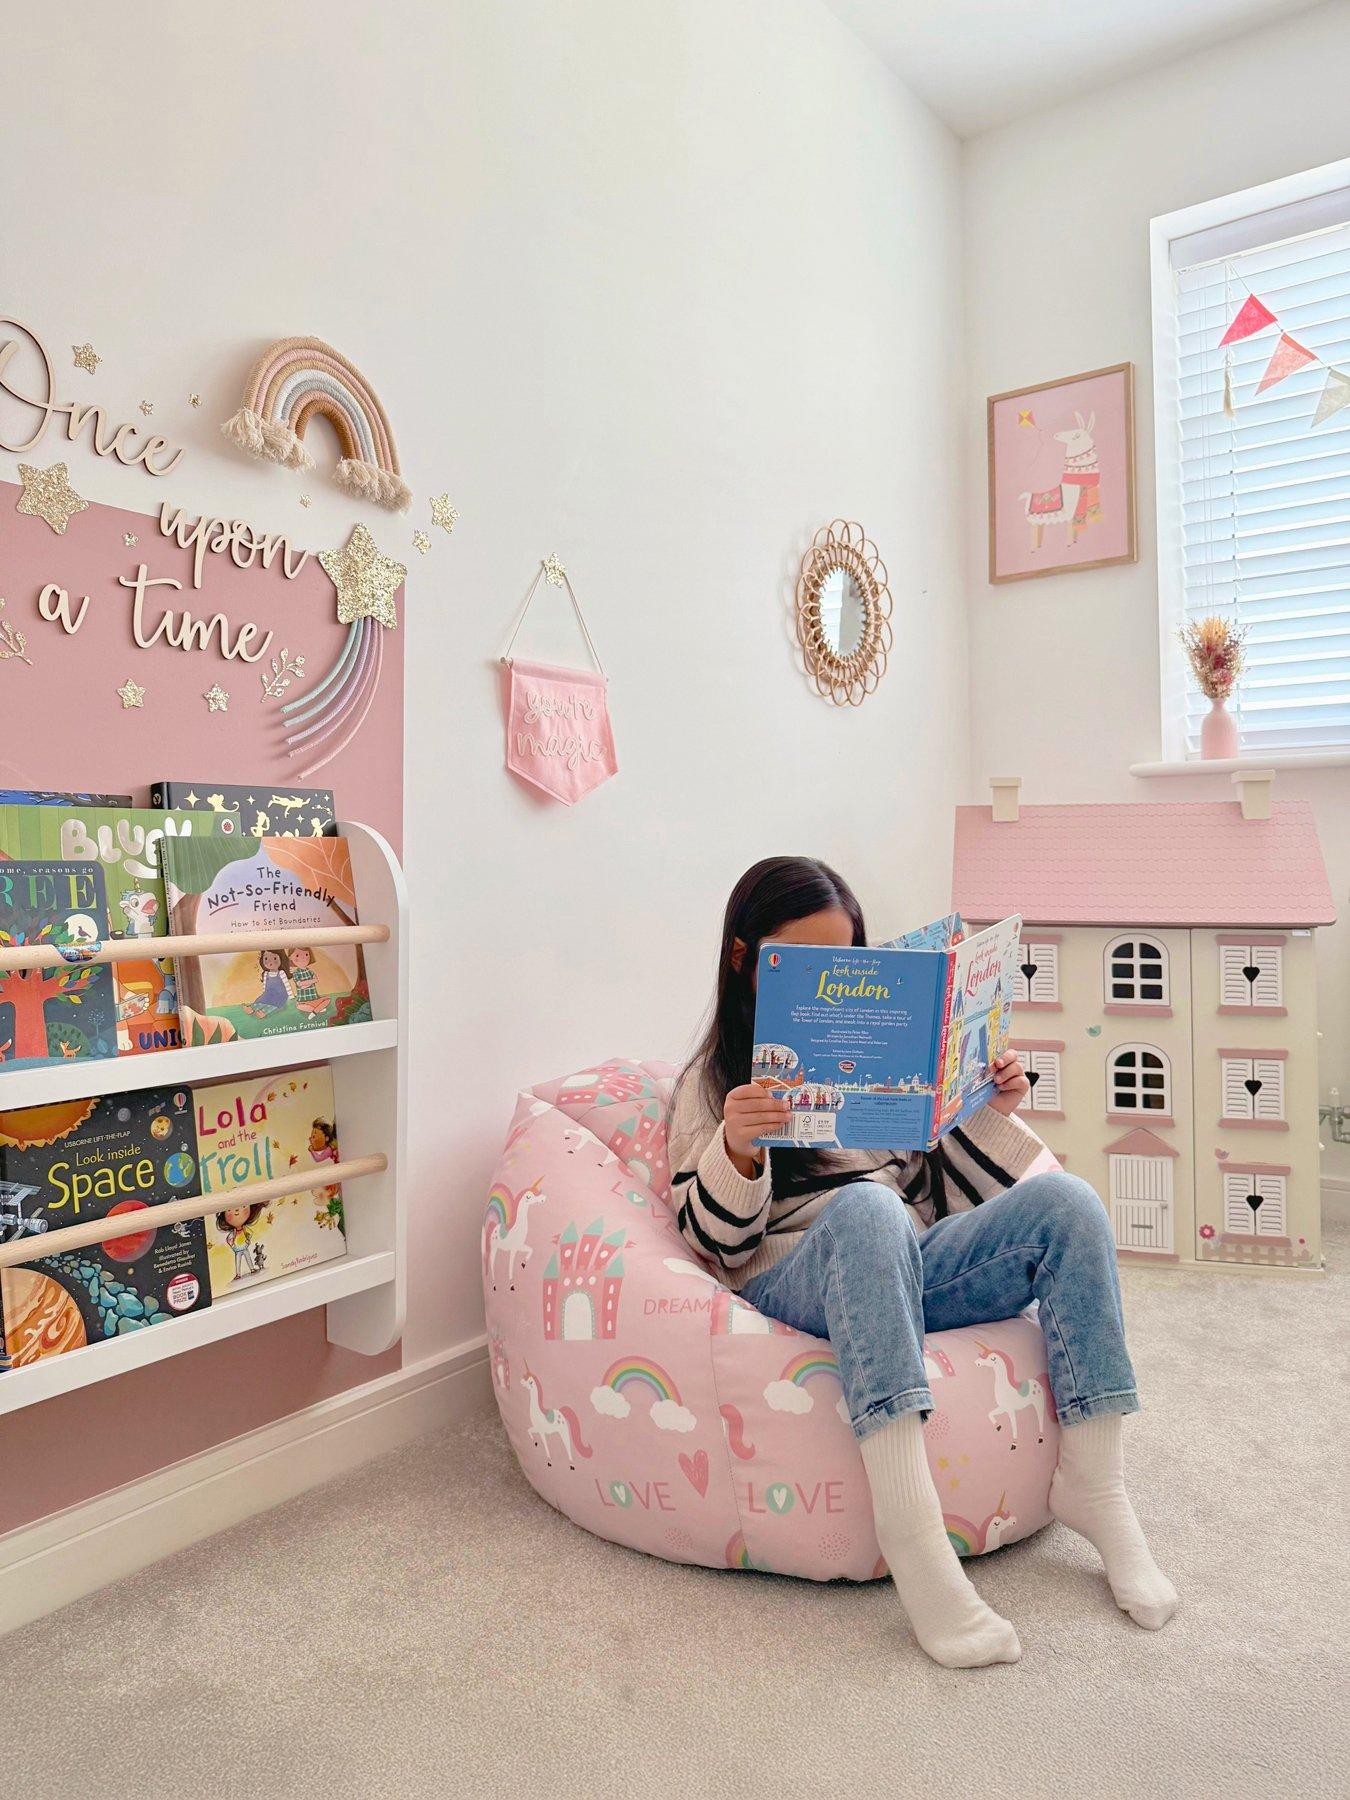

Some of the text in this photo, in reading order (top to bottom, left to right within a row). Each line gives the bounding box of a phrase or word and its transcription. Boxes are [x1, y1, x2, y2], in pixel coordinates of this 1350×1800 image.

[158, 500, 309, 590] upon
[38, 563, 274, 664] a time
[516, 732, 608, 771] magic
[256, 867, 281, 879] The
[207, 881, 335, 909] Not-So-Friendly
[253, 900, 296, 912] Friend
[231, 919, 249, 928] How
[263, 917, 276, 926] Set
[279, 916, 321, 925] Boundaries
[815, 970, 891, 1005] London
[964, 956, 1001, 997] London
[139, 1028, 181, 1050] UNI
[263, 1020, 328, 1035] Christina Furnival
[199, 1096, 267, 1136] Lola
[64, 1136, 92, 1148] USBORNE
[218, 1129, 257, 1149] and the
[76, 1143, 141, 1166] Look inside
[48, 1159, 155, 1214] Space
[643, 1298, 713, 1316] DREAM
[595, 1478, 676, 1512] LOVE
[747, 1480, 844, 1514] LOVE
